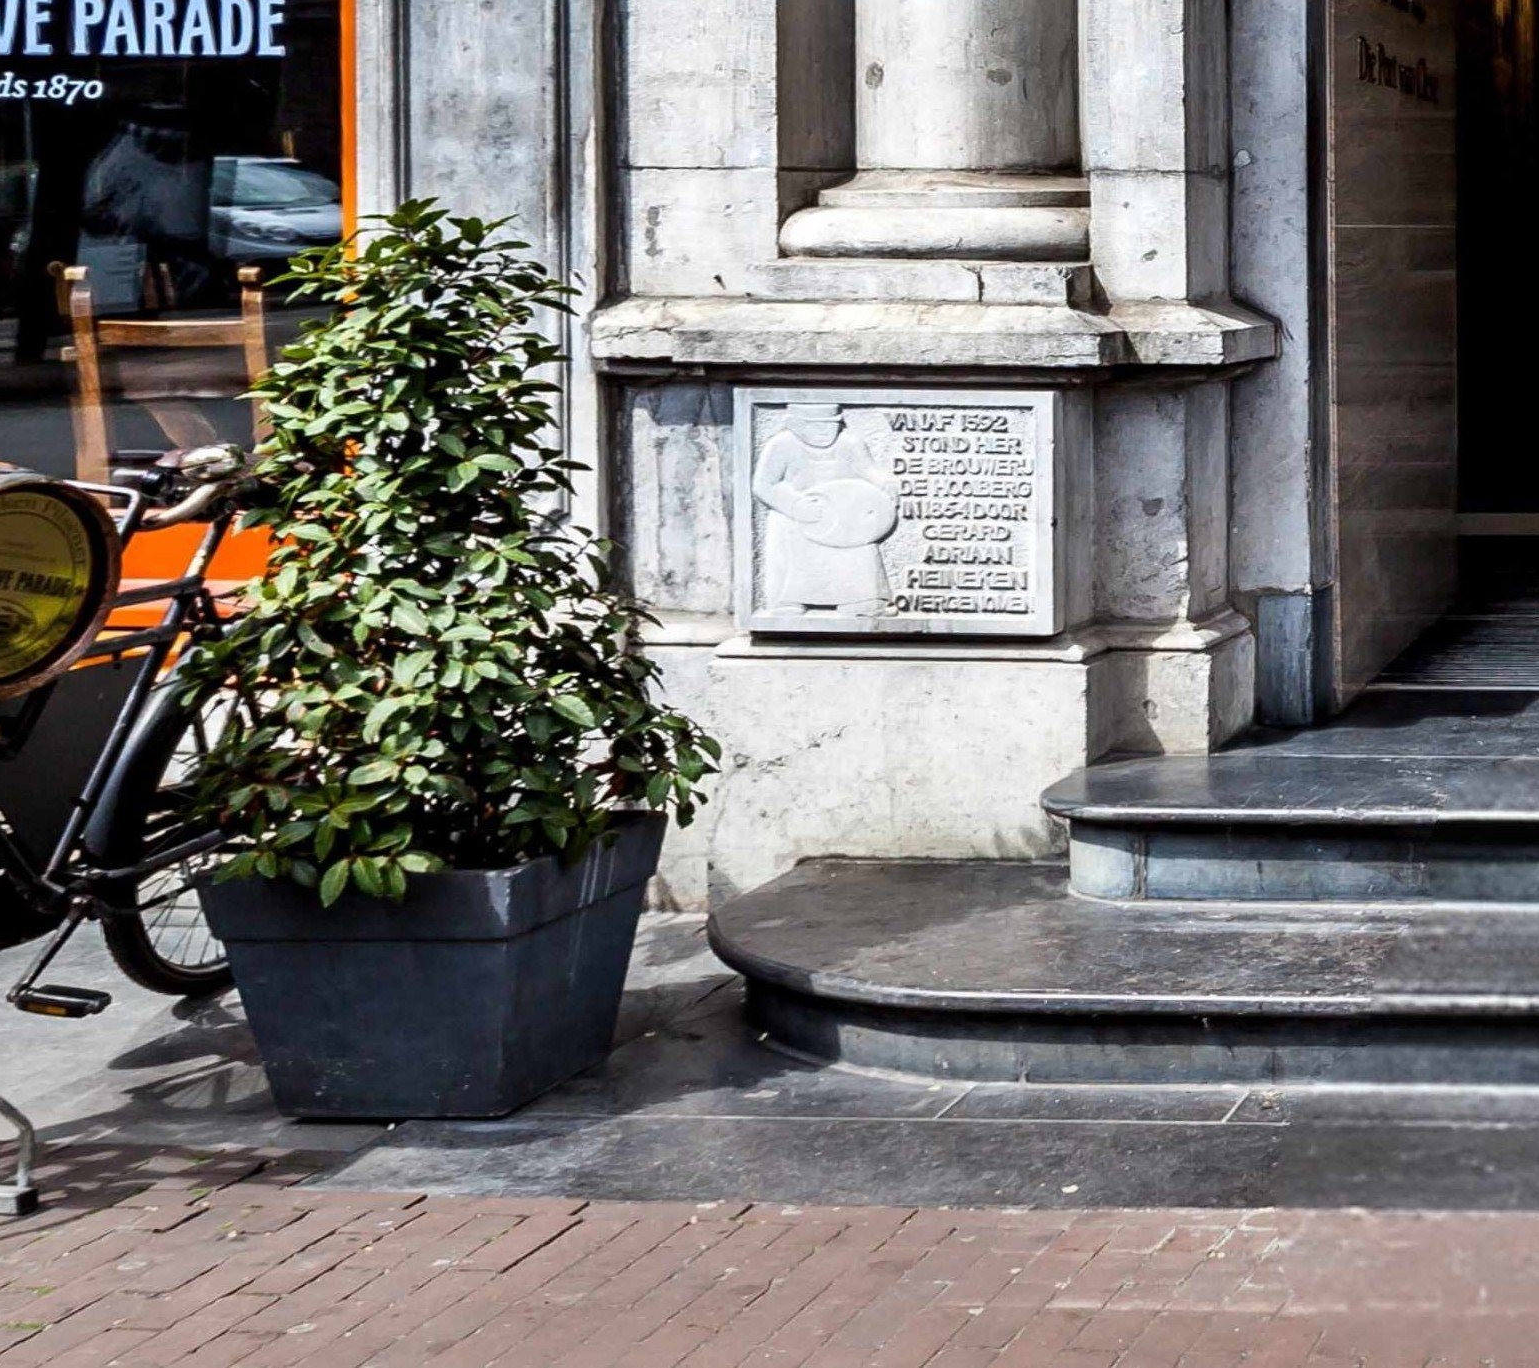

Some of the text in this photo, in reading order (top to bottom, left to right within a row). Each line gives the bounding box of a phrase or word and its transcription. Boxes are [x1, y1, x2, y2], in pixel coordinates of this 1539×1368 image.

[31, 74, 104, 106] 1870
[889, 412, 1009, 434] VANAF 1592
[902, 436, 1023, 455] STOND HIER
[893, 457, 923, 475] DE
[899, 478, 928, 497] DE
[902, 500, 923, 519] IN
[973, 502, 1028, 521] DOOR
[922, 524, 1011, 542] GERARD
[922, 545, 1014, 565] ADRIAAN
[907, 569, 1028, 591] HEINEKEN
